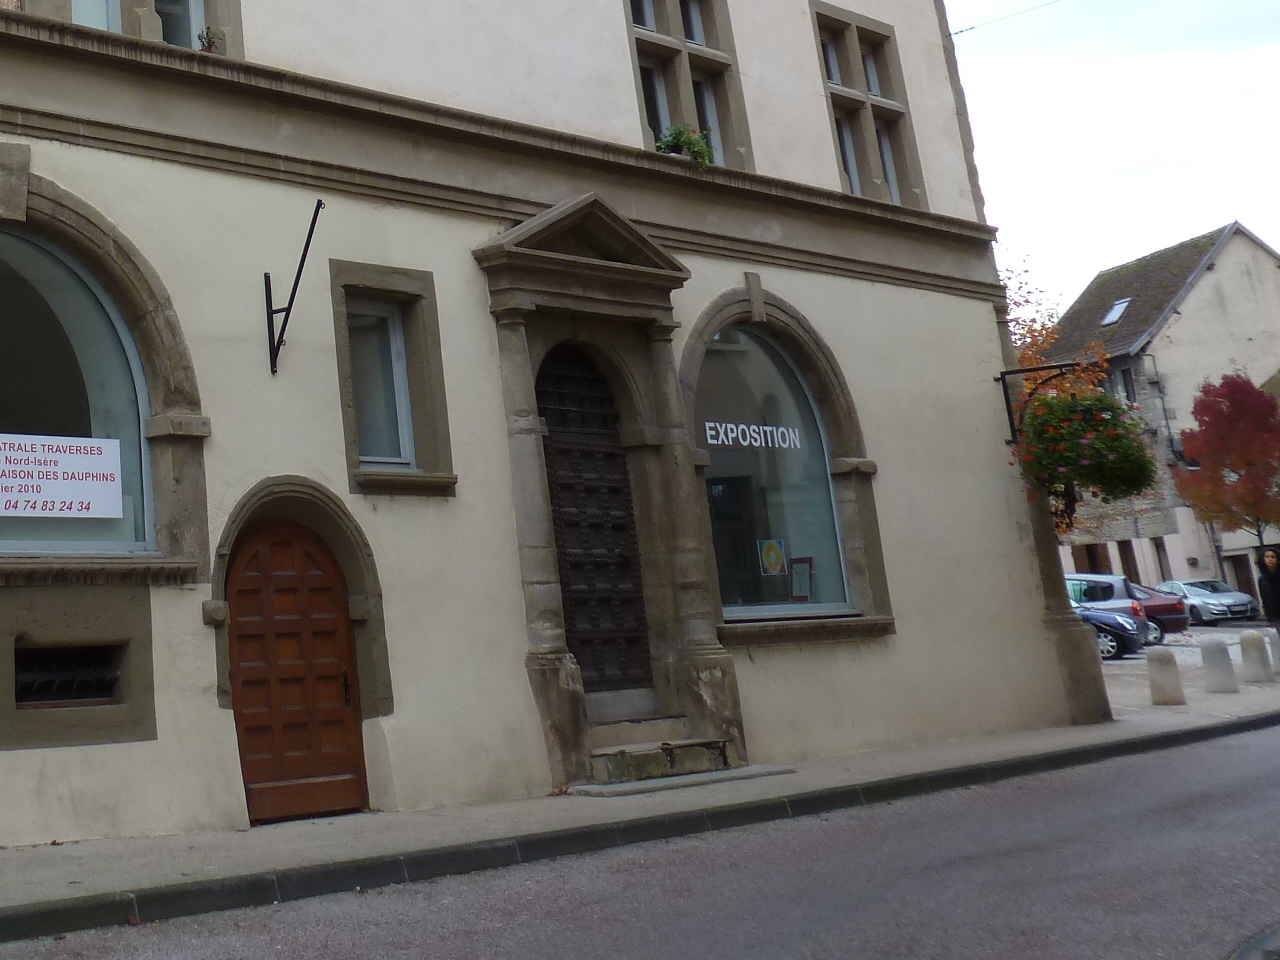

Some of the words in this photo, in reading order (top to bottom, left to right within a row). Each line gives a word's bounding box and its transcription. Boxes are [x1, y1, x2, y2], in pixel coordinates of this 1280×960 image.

[705, 421, 801, 449] EXPOSITION
[40, 443, 103, 456] TRAVERSES
[5, 455, 60, 467] Nord-Isère
[37, 470, 59, 481] DES
[62, 471, 116, 483] DAUPHINS
[17, 483, 42, 494] 2010
[4, 499, 19, 511] 04
[23, 500, 38, 511] 74
[41, 500, 56, 512] 83
[58, 501, 74, 512] 24
[77, 501, 91, 512] 34
